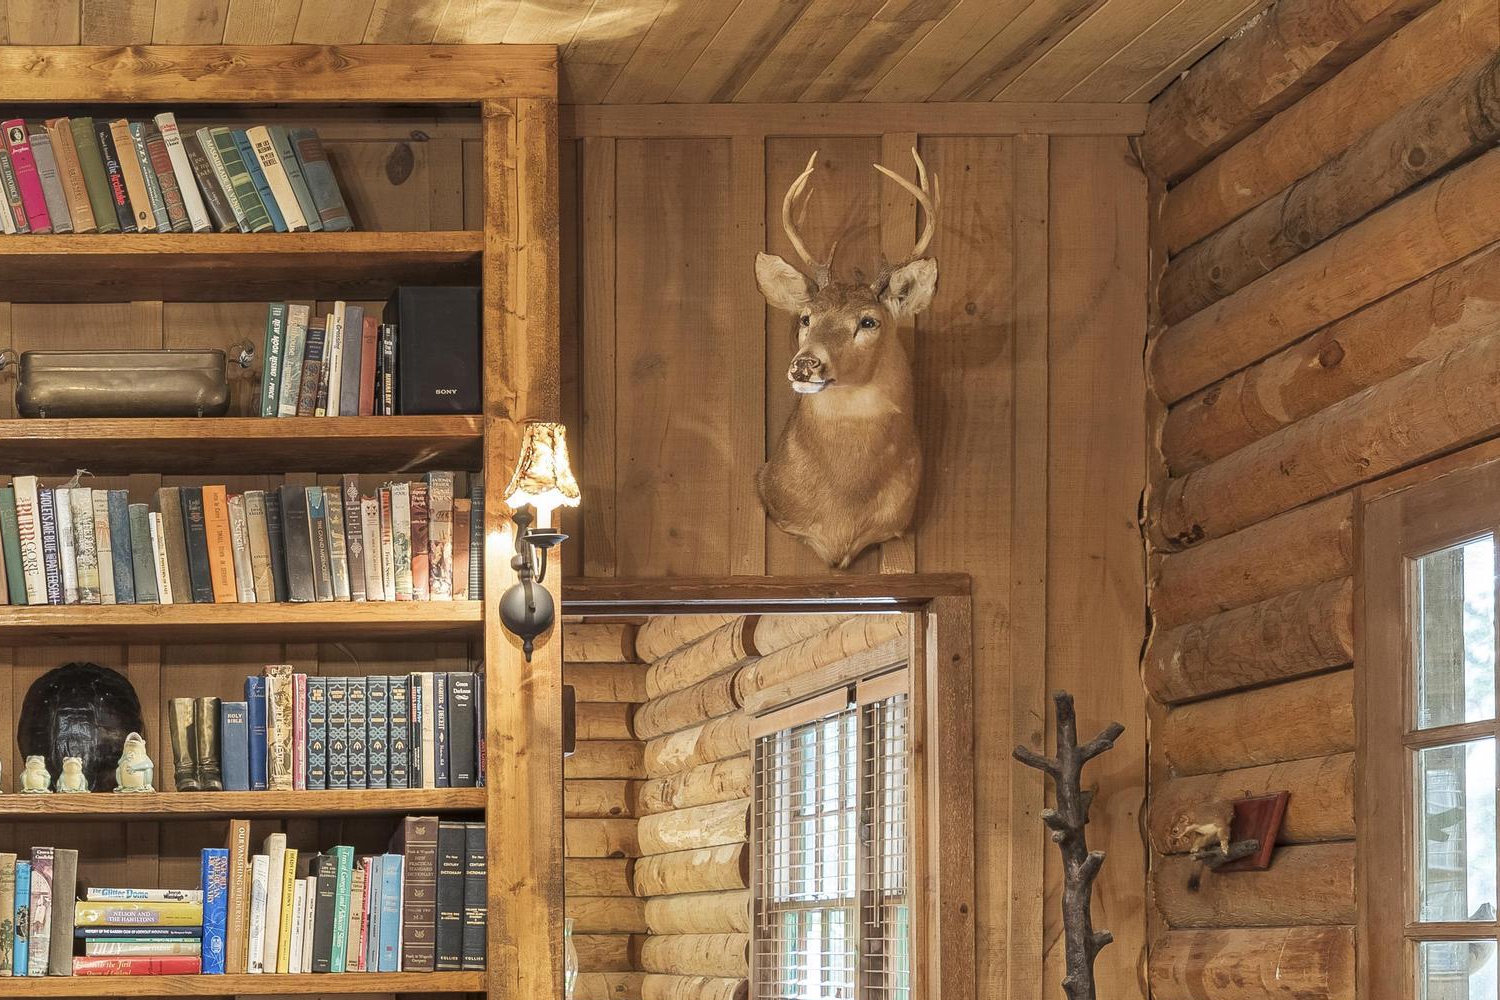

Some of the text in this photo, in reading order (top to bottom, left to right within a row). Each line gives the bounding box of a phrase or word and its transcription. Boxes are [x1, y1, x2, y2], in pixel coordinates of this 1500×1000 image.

[1, 156, 18, 200] THE DIVORCE
[205, 140, 229, 184] MASQUERADE
[228, 193, 243, 216] VENICE
[270, 336, 280, 354] MOON
[270, 355, 279, 377] RISING
[267, 382, 276, 400] PRICE
[17, 499, 39, 576] BURR GORE
[40, 491, 60, 598] VIOLETS ARE BLUE PATTERSON
[233, 519, 245, 551] Serpent
[236, 845, 245, 885] VANISHING
[126, 889, 149, 899] Dome
[234, 886, 243, 932] WILDERNESS
